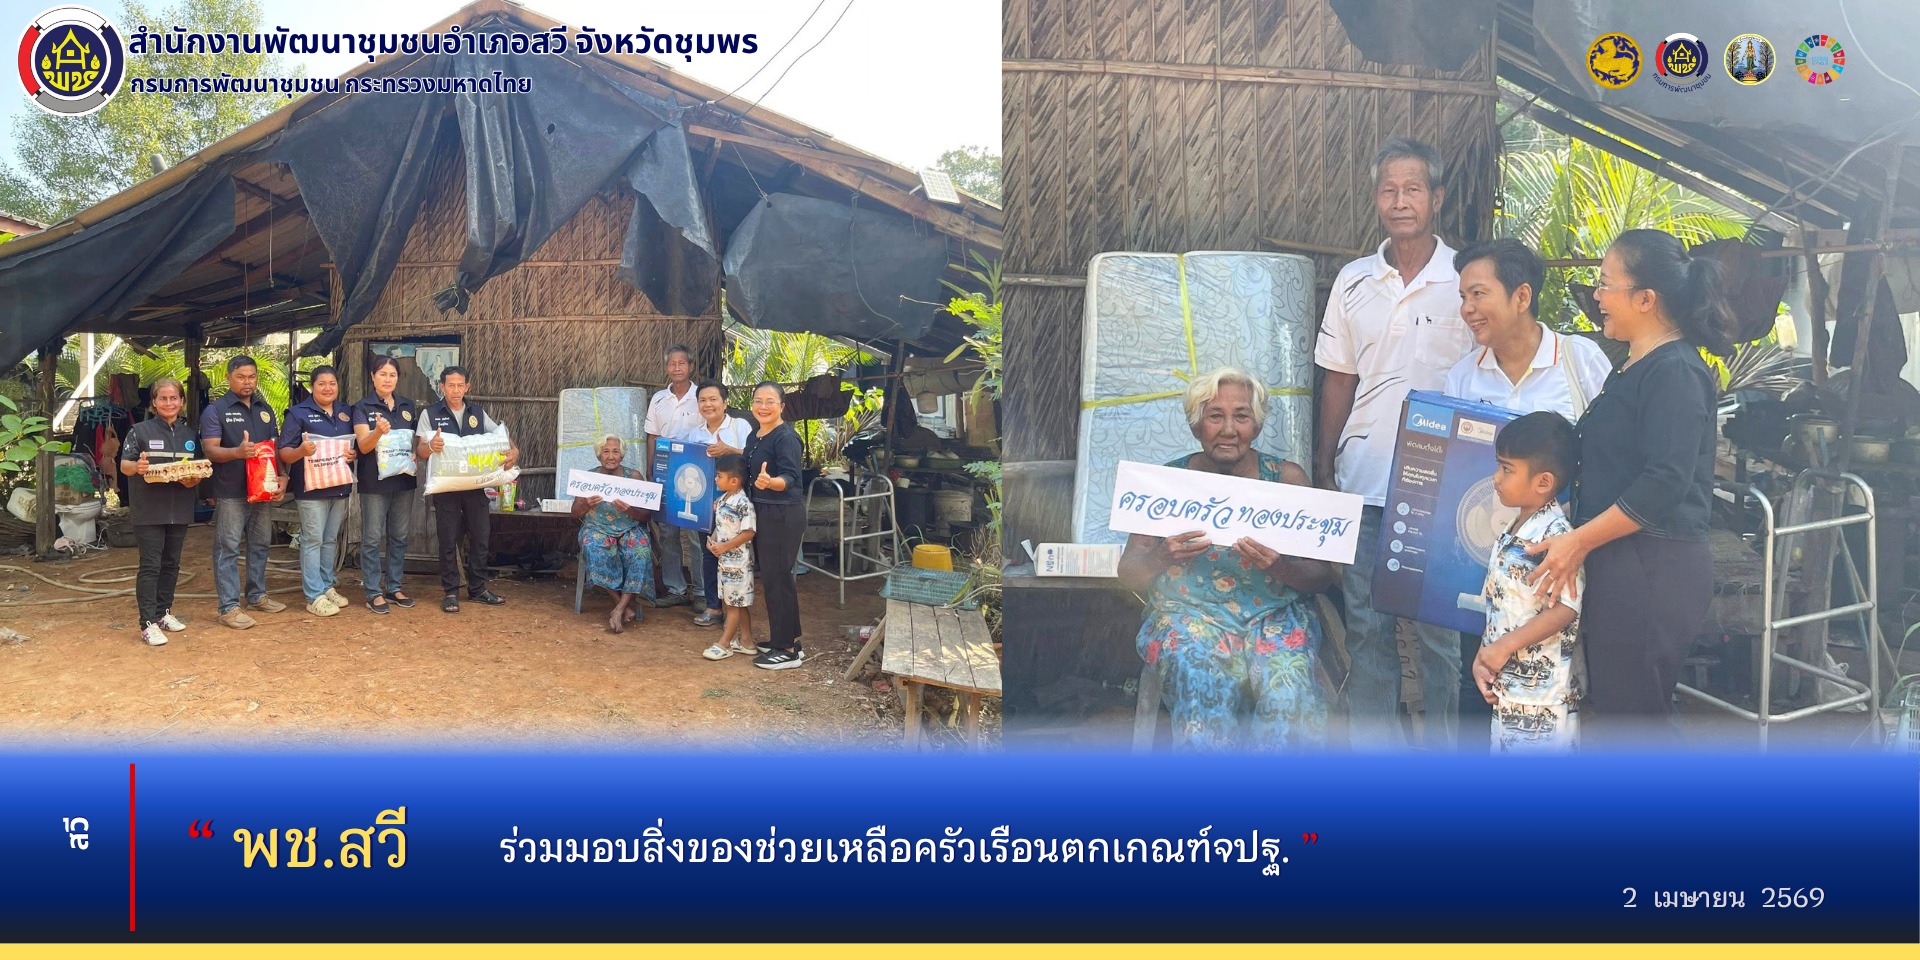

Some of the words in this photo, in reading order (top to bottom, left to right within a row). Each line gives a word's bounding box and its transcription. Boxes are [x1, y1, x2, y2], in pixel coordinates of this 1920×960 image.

[1411, 413, 1447, 431] Midea
[569, 479, 613, 496] ครอบครัว
[613, 487, 658, 504] ทองประชุม
[1118, 490, 1233, 530] ครอบครัว
[1239, 504, 1355, 548] ทองประชุม
